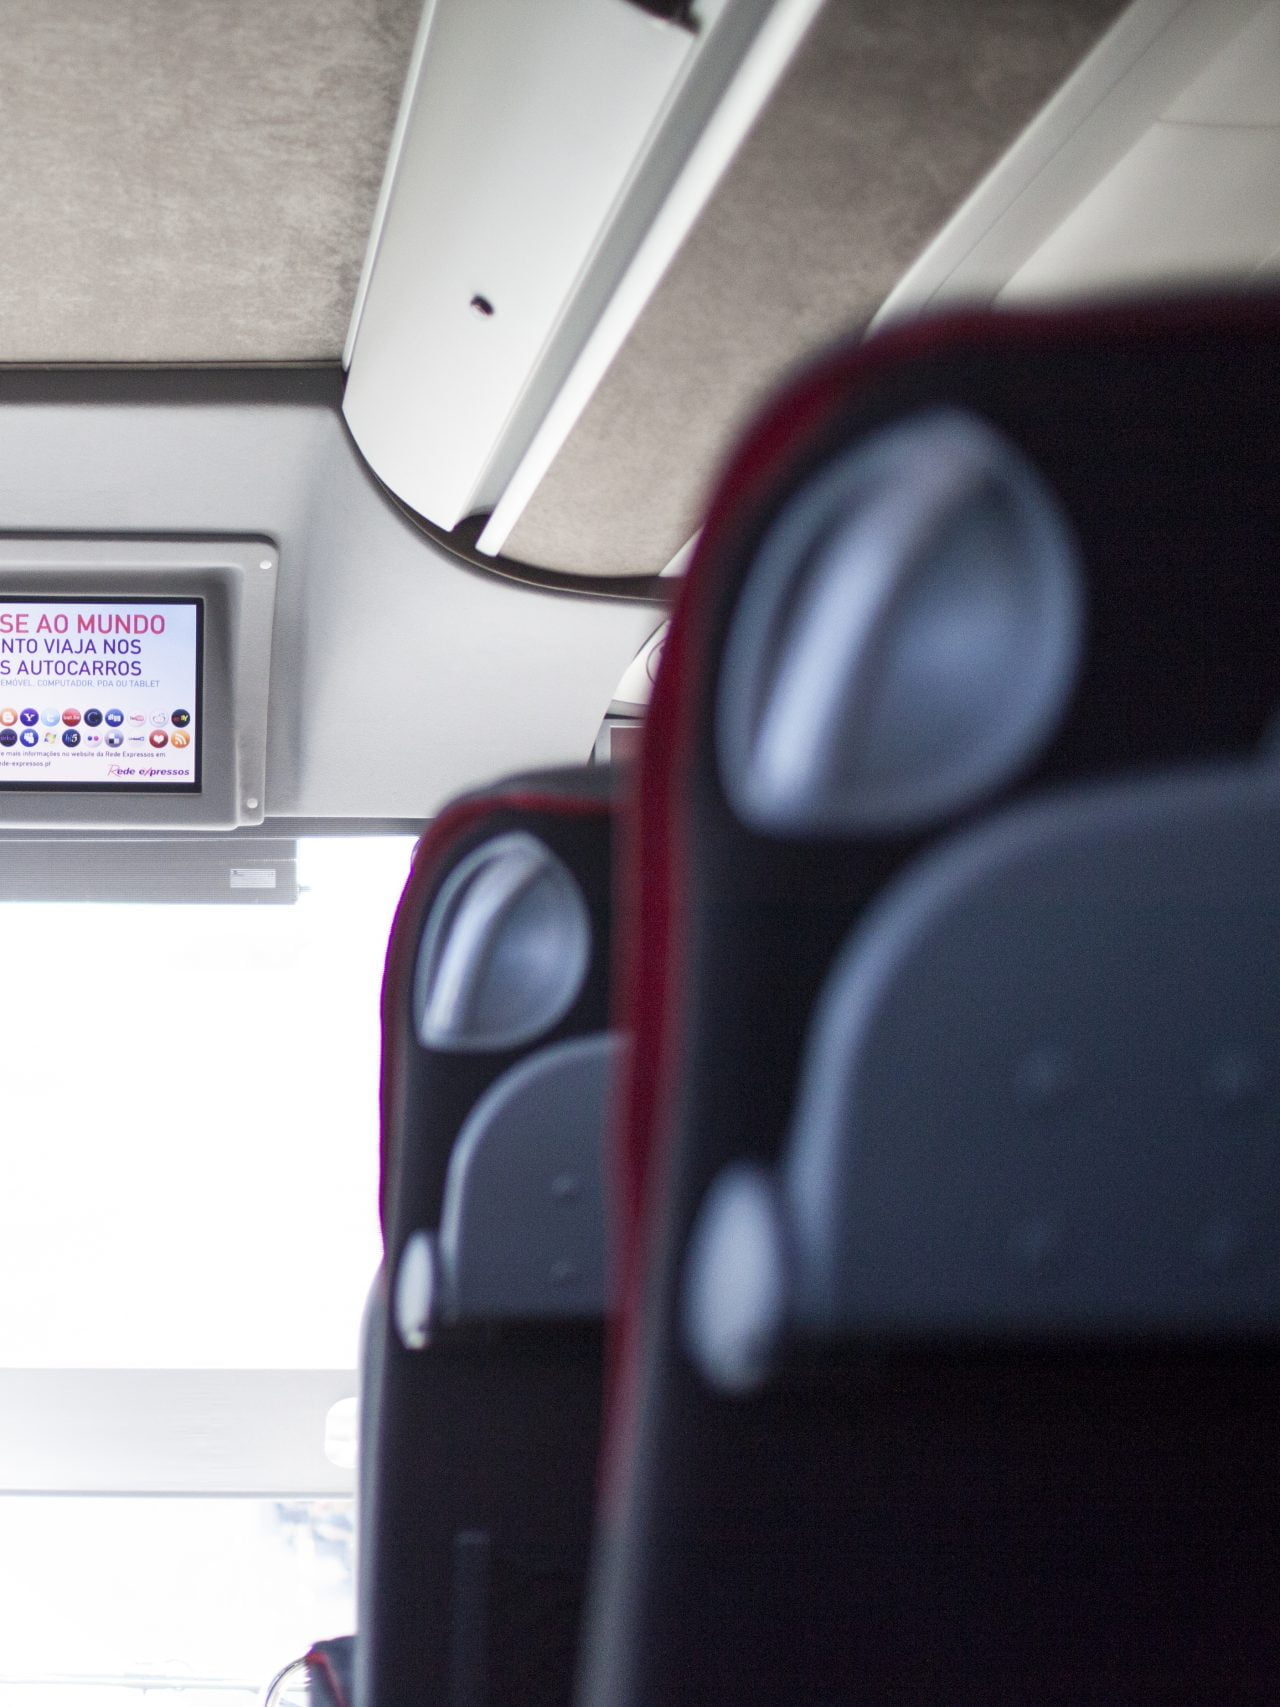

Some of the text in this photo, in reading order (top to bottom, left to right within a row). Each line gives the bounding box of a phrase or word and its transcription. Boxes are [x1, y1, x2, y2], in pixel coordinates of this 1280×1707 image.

[35, 614, 69, 634] AO
[77, 614, 165, 635] MUNDO
[44, 638, 97, 654] VIAJA
[103, 639, 142, 655] NOS
[17, 660, 142, 676] AUTOCARROS
[97, 679, 114, 687] PDA
[116, 679, 128, 688] OU
[130, 679, 161, 688] TABLET
[71, 750, 95, 758] website
[122, 751, 155, 759] Expressos
[107, 764, 136, 777] Rede
